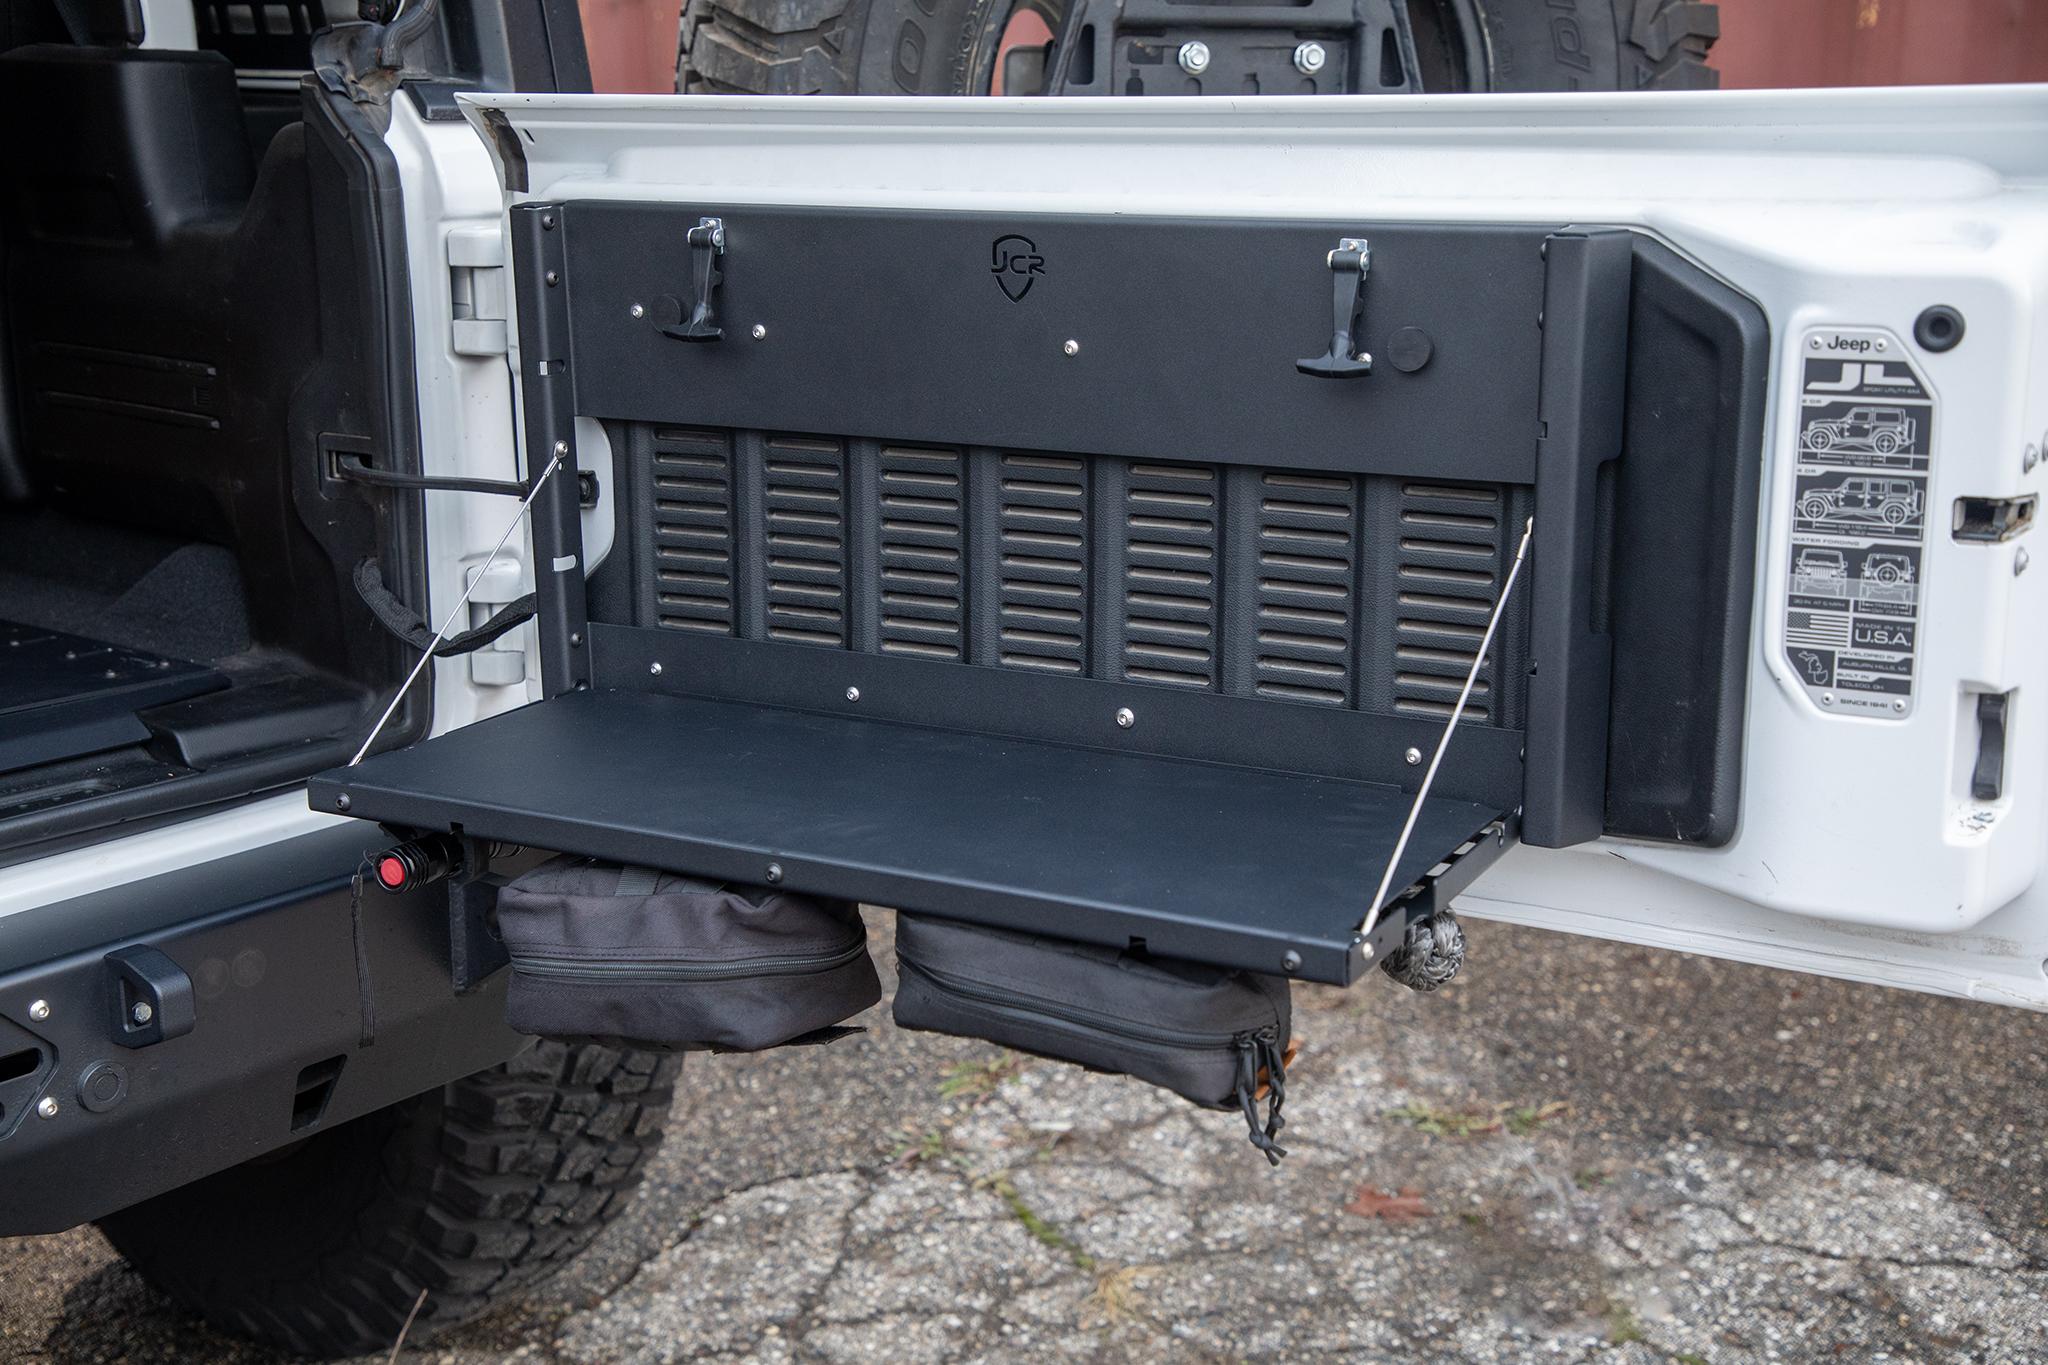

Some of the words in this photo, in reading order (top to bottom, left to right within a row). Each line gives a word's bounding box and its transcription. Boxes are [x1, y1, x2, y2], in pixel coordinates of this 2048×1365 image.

[991, 250, 1046, 275] JCR
[1827, 335, 1871, 353] Jeep
[1806, 362, 1916, 392] JL
[1896, 625, 1912, 633] THE
[1855, 629, 1911, 646] U.S.A.
[1838, 650, 1885, 659] DEVELOPED
[1842, 661, 1873, 669] AUBURN
[1840, 698, 1868, 706] SINCE
